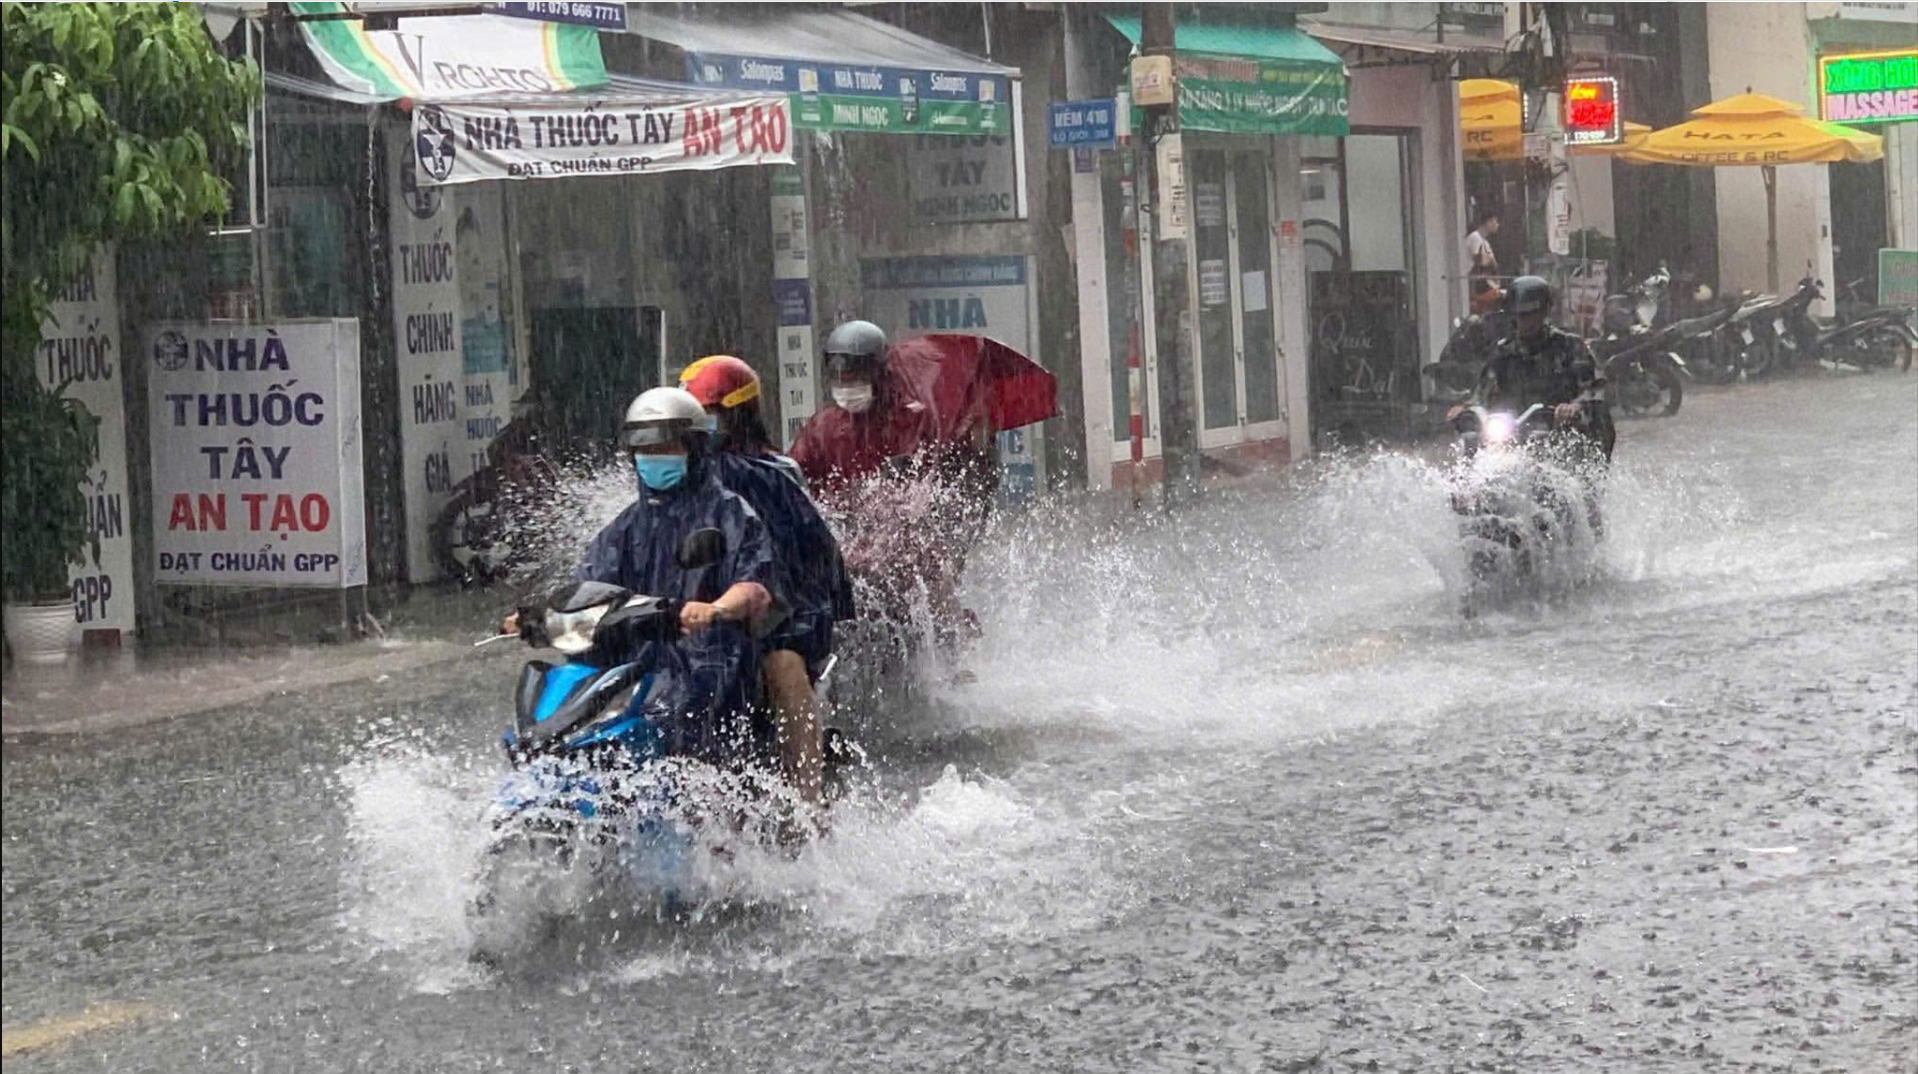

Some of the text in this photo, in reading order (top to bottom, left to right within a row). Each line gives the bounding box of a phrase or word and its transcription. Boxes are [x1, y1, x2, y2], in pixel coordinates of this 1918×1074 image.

[548, 2, 569, 15] 079
[572, 3, 592, 18] 666
[594, 6, 620, 21] 7771
[1826, 89, 1918, 120] MASSAGE
[464, 107, 522, 151] NHÀ
[529, 100, 620, 148] THUỐC
[625, 106, 674, 145] TÂY
[683, 107, 722, 157] AN
[730, 104, 786, 164] TẠO
[1467, 131, 1493, 143] RC
[1683, 130, 1786, 141] HATA
[550, 152, 611, 174] CHUẨN
[618, 156, 652, 171] GPP
[1763, 150, 1788, 162] RC
[401, 227, 453, 285] THUỐC
[406, 303, 455, 354] CHÍNH
[908, 293, 988, 329] NHÀ
[43, 318, 114, 386] THUỐC
[195, 329, 289, 371] NHÀ
[165, 378, 324, 427] THUỐC
[201, 436, 291, 479] TÂY
[168, 492, 331, 541] AN TẠO
[160, 544, 340, 576] ĐẠT CHUẨN GPP
[73, 574, 112, 623] GPP
